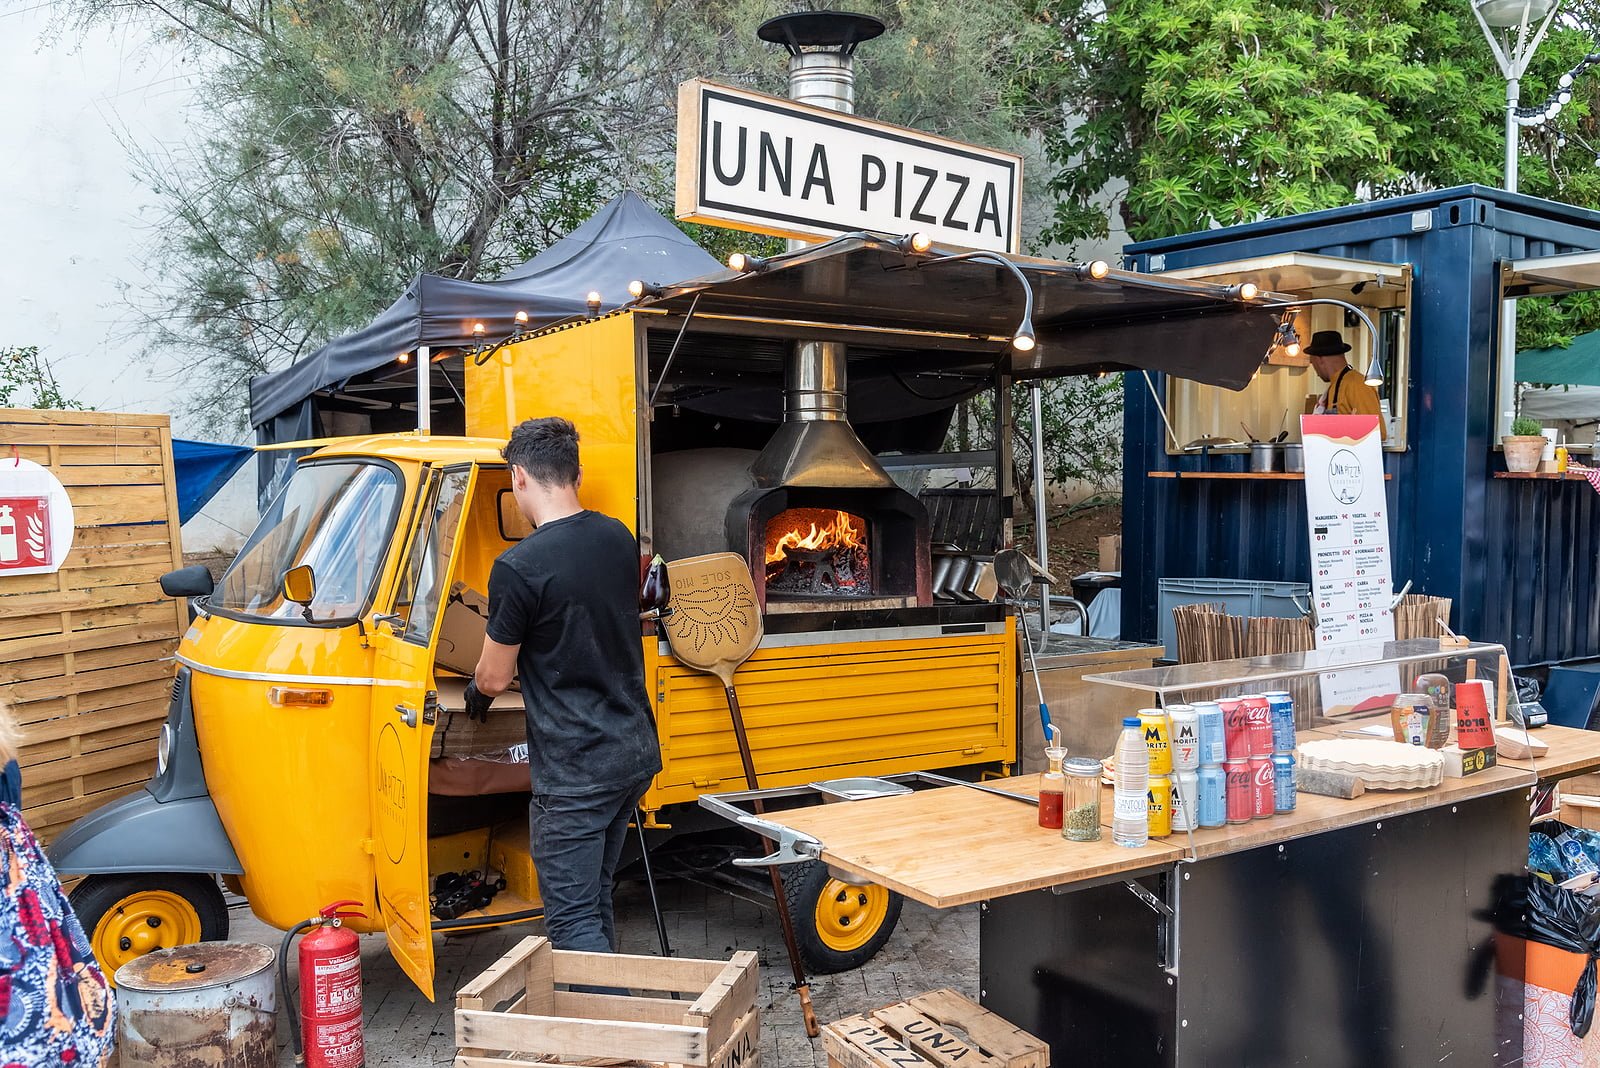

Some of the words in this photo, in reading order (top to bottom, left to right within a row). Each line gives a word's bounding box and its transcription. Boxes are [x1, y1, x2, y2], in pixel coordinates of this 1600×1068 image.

[713, 121, 834, 205] UNA
[860, 154, 1002, 237] PIZZA
[675, 577, 694, 589] MIO
[701, 571, 731, 585] SOLE
[1182, 748, 1192, 760] 7
[721, 1032, 751, 1068] NA
[903, 1020, 970, 1061] UNA
